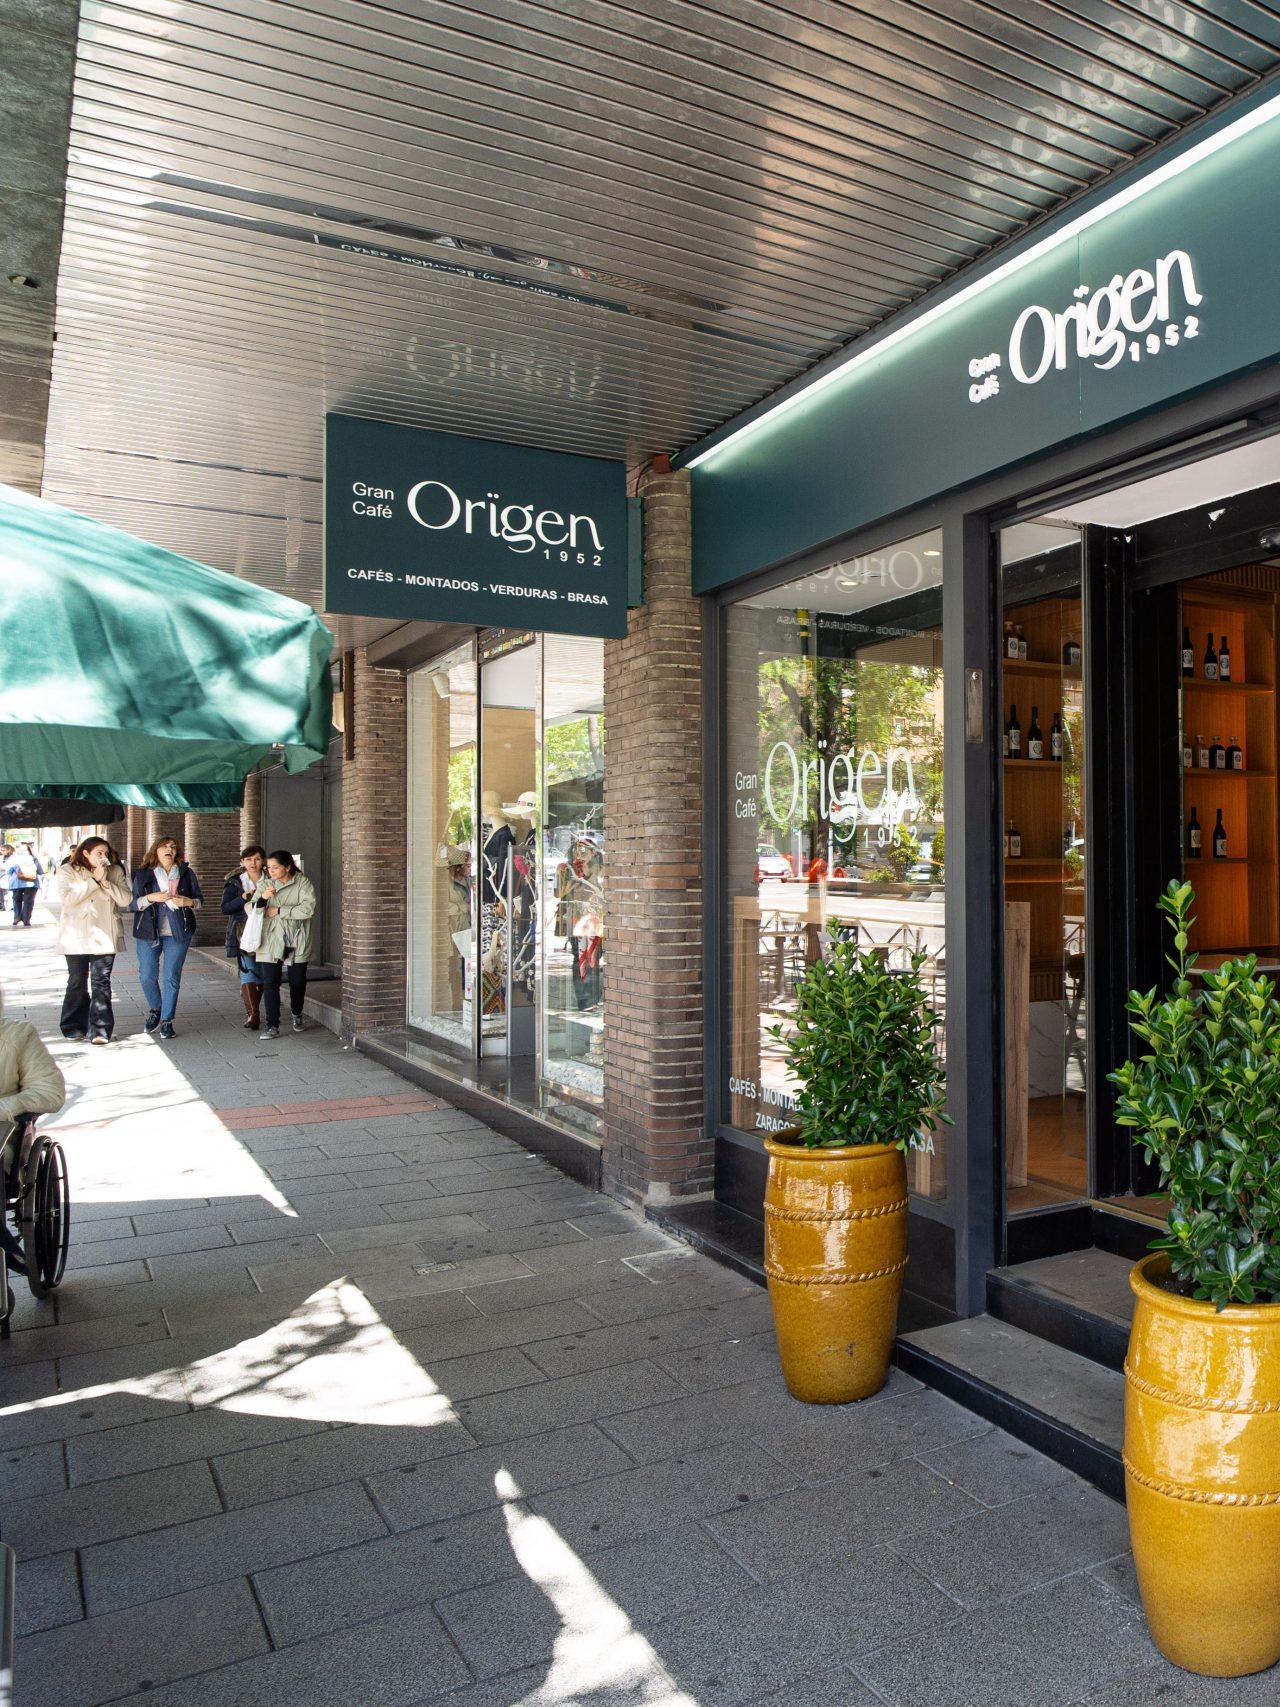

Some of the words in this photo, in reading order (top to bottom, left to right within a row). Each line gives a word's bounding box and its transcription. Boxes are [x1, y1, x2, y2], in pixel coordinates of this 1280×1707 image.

[352, 482, 394, 500] Gran
[352, 501, 393, 519] Café
[543, 549, 601, 566] 1952
[347, 568, 394, 582] CAFÉS
[405, 574, 479, 592] MONTADOS
[490, 584, 558, 600] VERDURAS
[568, 592, 608, 605] BRASA
[735, 772, 757, 790] Gran
[735, 798, 756, 818] Café
[729, 1077, 756, 1099] CAFÉS
[910, 1133, 935, 1156] ASA
